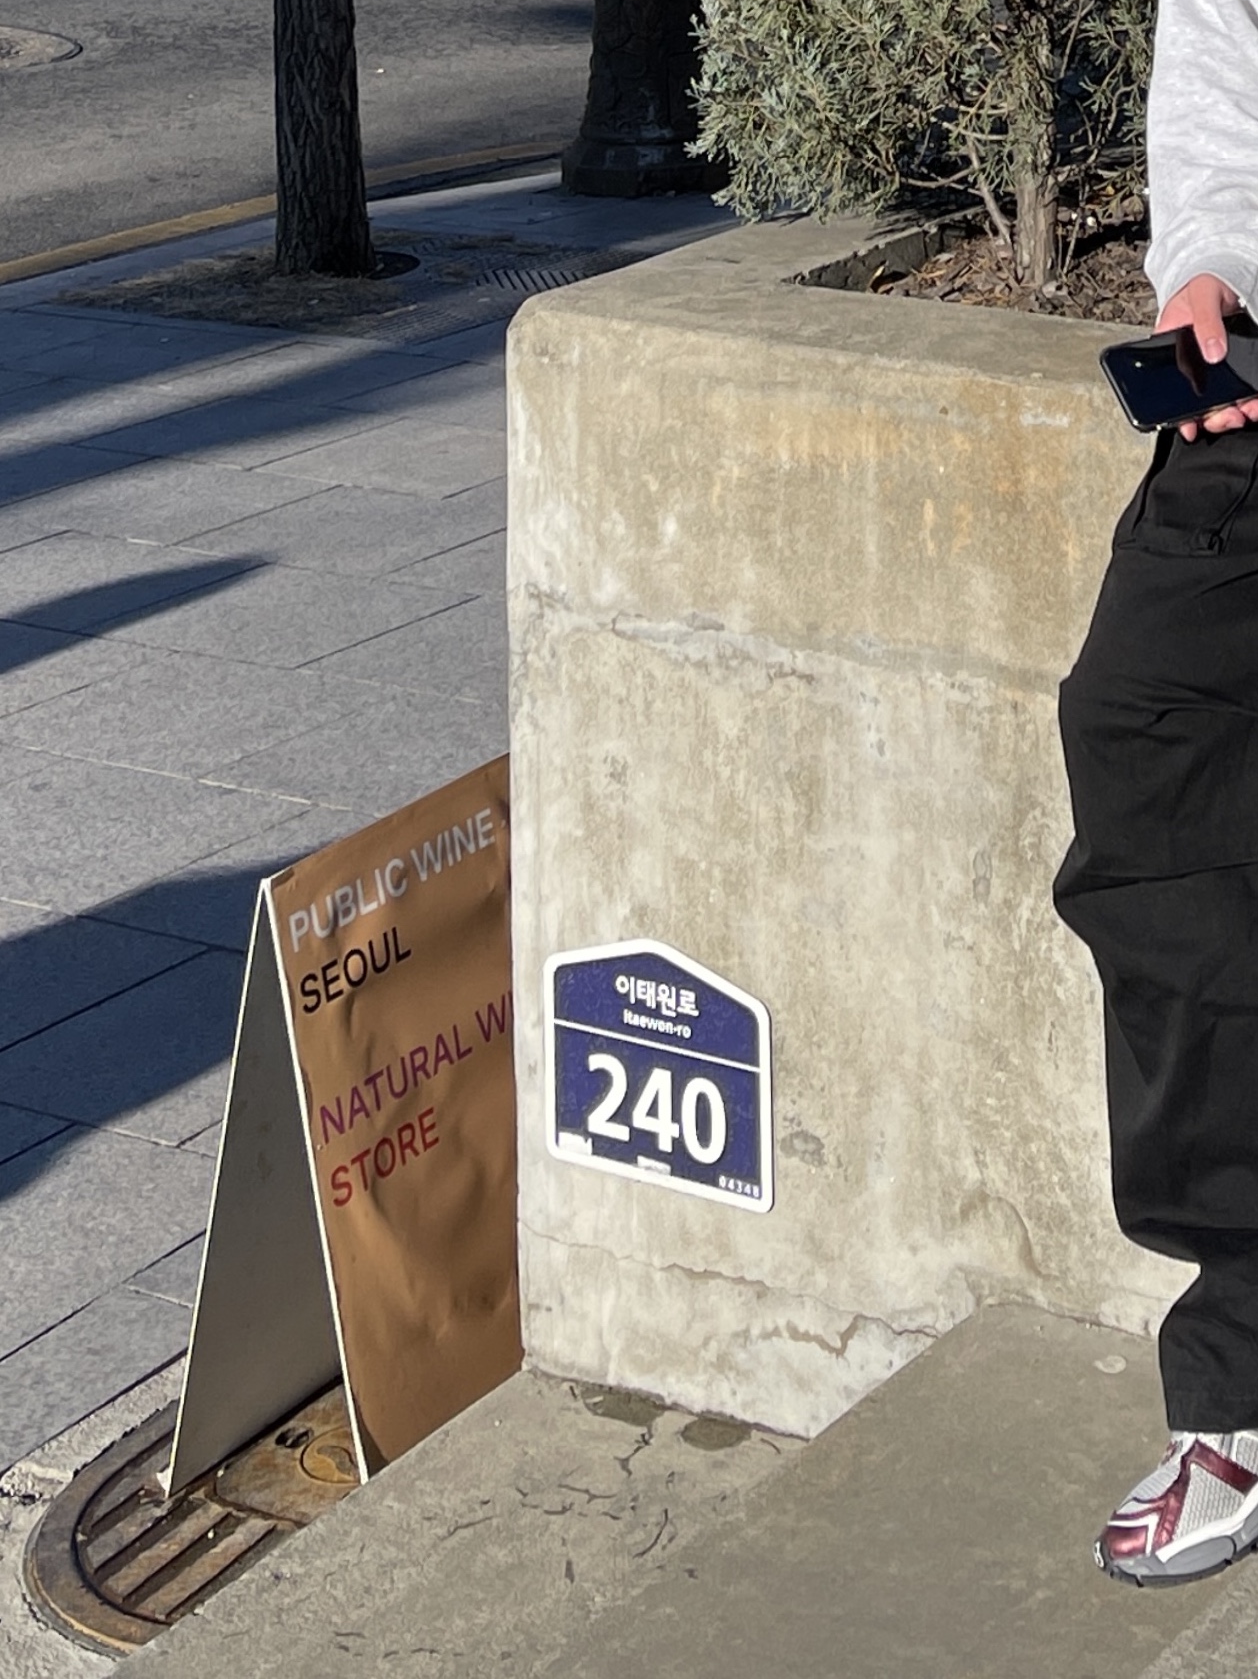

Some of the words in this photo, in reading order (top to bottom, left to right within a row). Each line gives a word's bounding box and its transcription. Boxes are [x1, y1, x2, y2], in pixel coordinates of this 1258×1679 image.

[288, 857, 408, 952] PUBLIC
[410, 807, 496, 882] WINE
[300, 926, 412, 1014] SEOUL
[615, 974, 700, 1018] 이태원로
[623, 1008, 692, 1039] Itaewon-ro
[319, 1024, 473, 1145] NATURAL
[587, 1053, 727, 1165] 240
[330, 1107, 441, 1208] STORE
